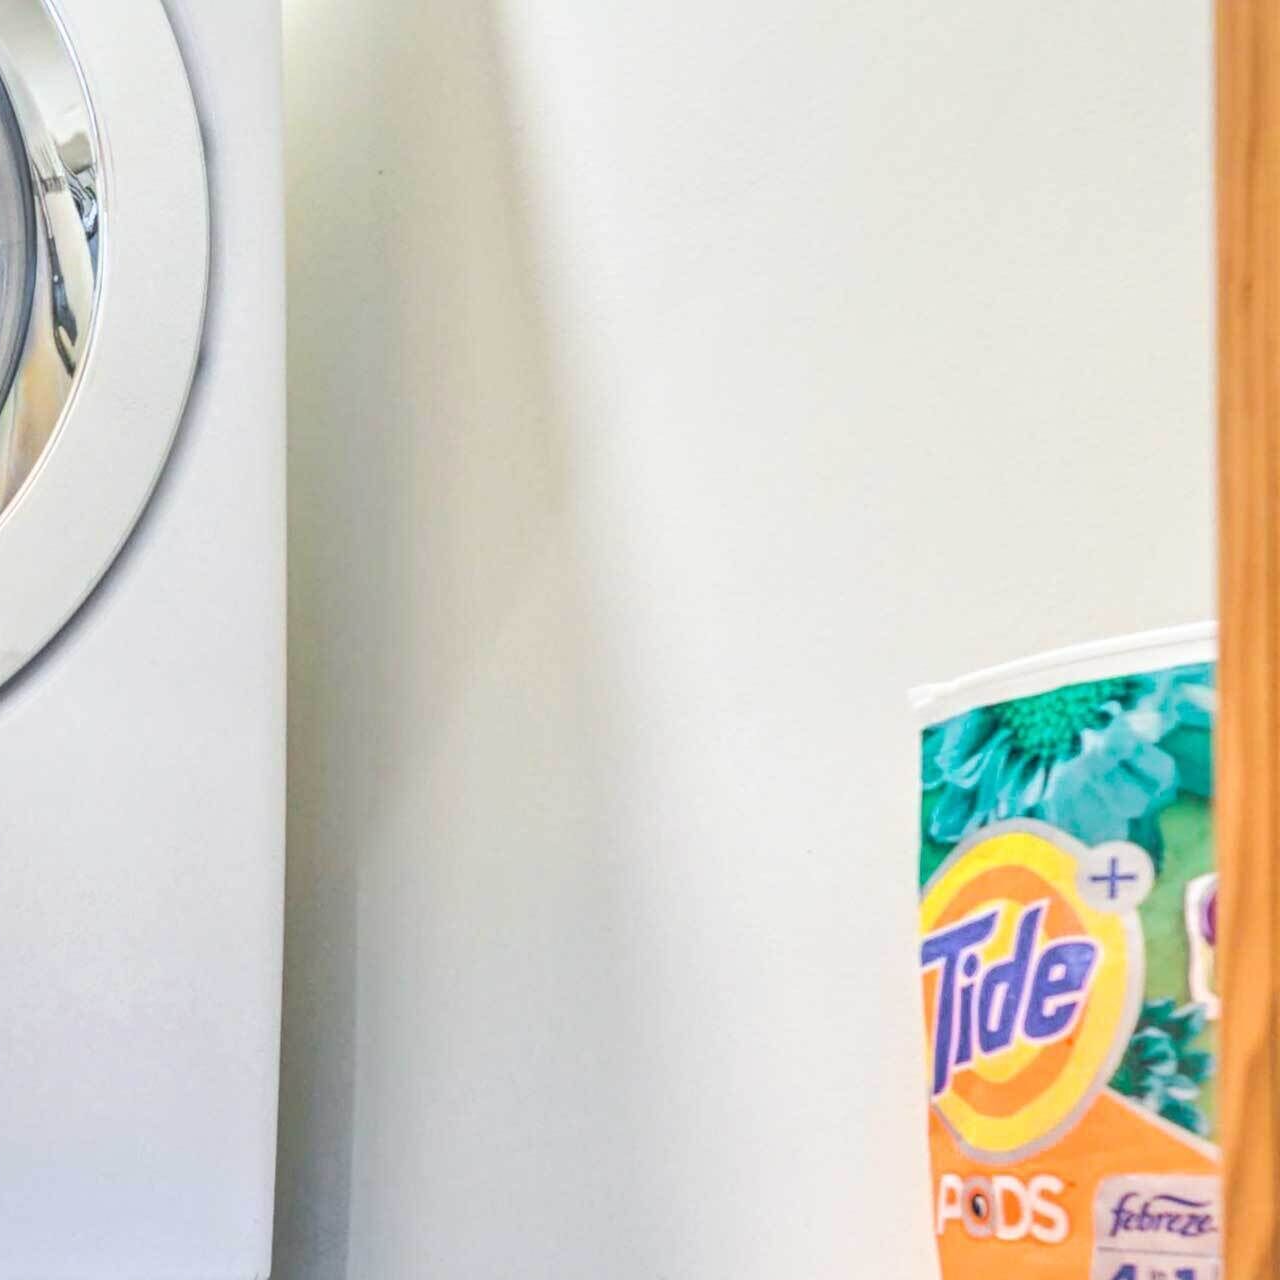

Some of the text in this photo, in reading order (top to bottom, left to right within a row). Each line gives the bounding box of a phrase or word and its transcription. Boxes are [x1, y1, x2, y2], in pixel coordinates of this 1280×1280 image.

[920, 904, 1097, 1096] Tide
[936, 1173, 1070, 1244] PODS
[1108, 1191, 1218, 1238] febreze
